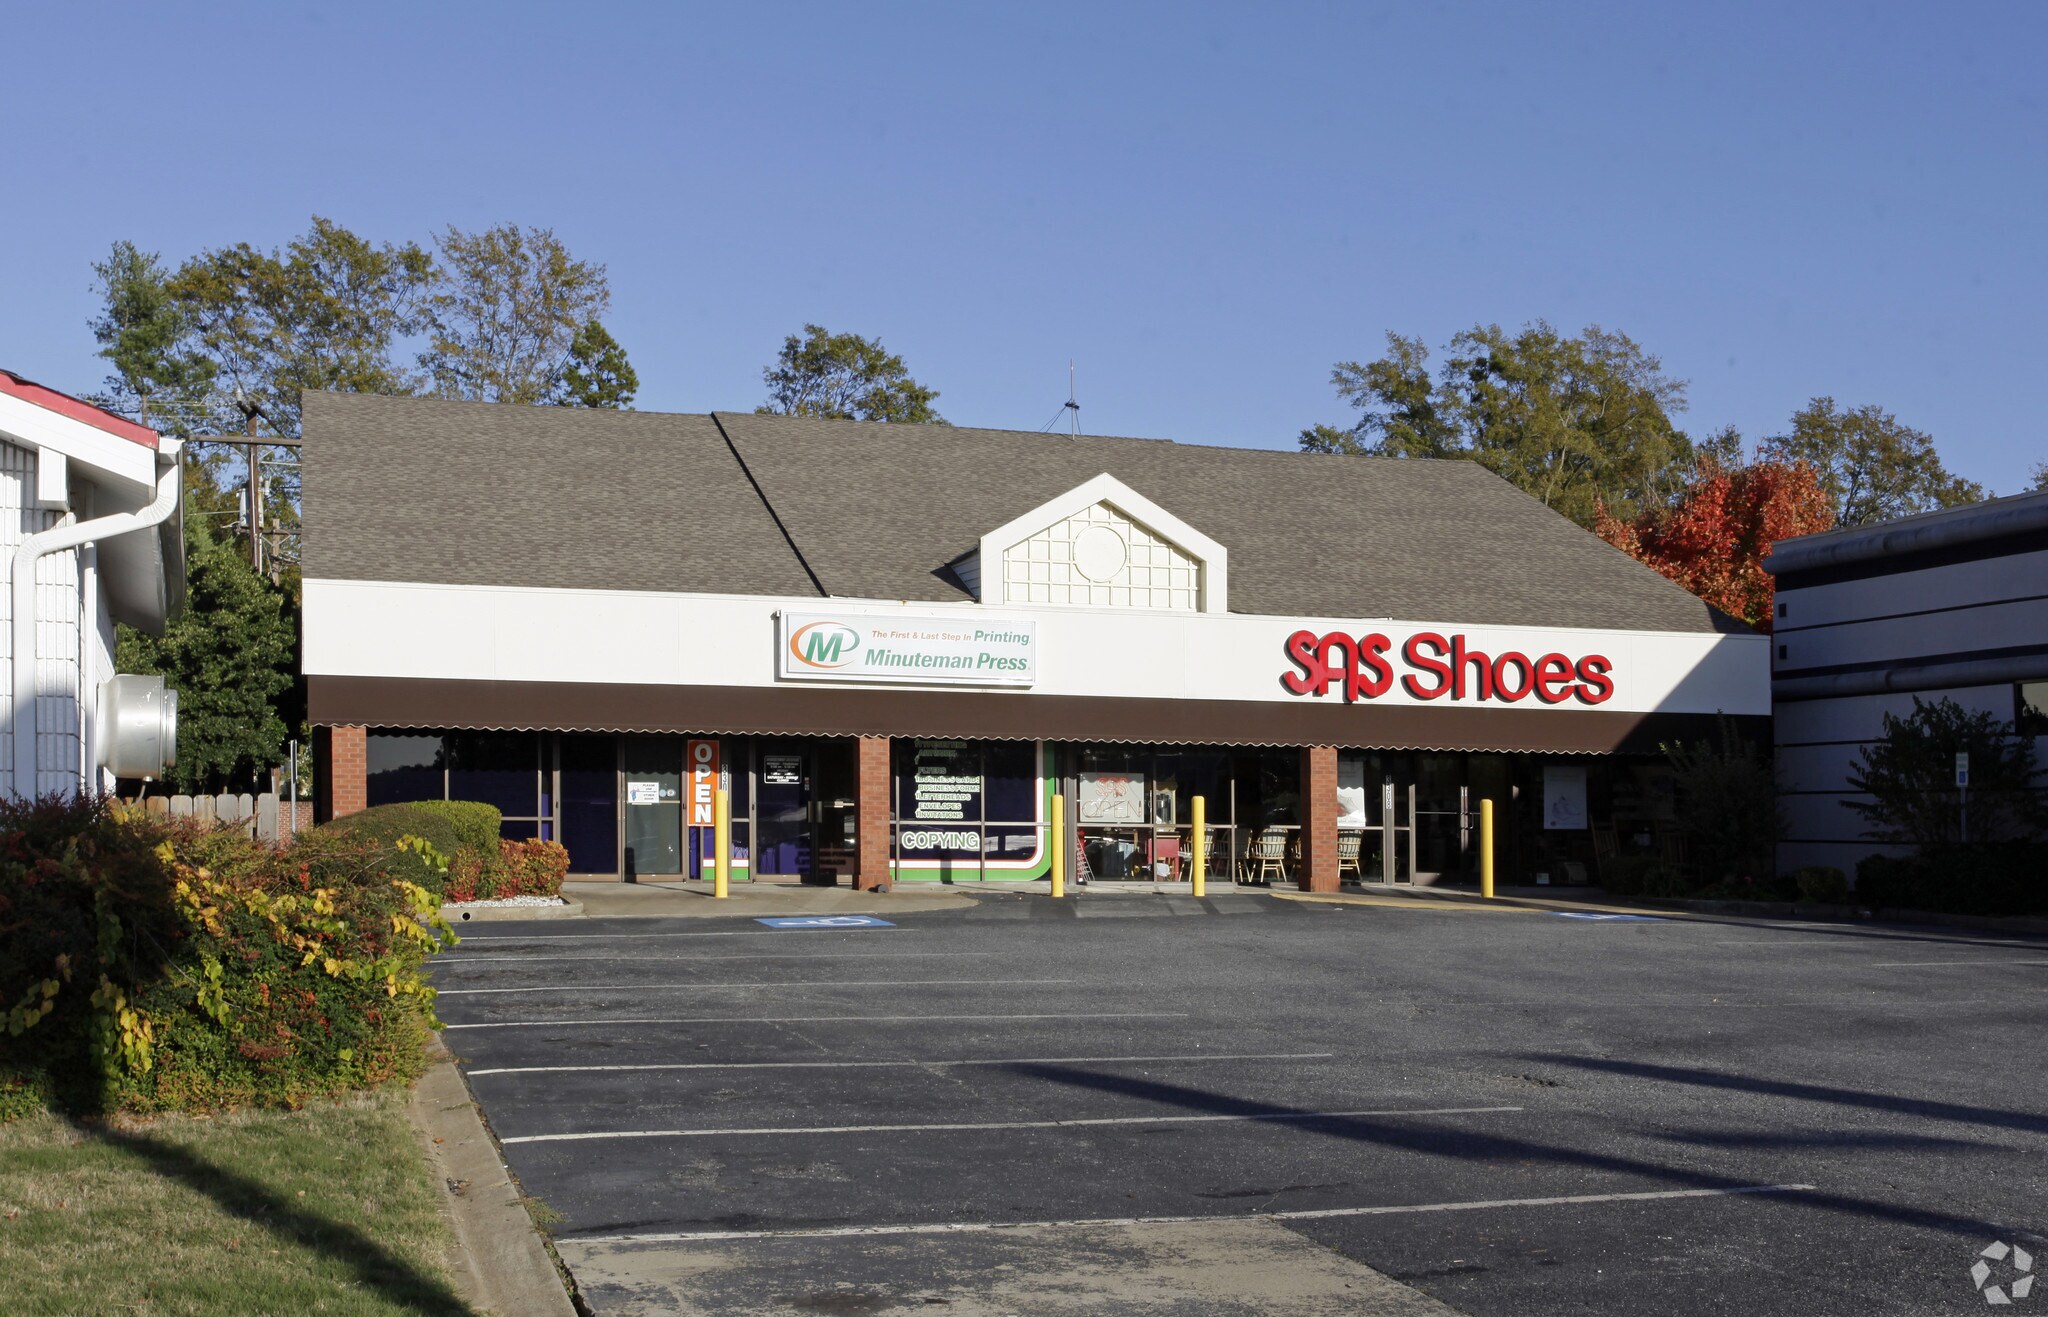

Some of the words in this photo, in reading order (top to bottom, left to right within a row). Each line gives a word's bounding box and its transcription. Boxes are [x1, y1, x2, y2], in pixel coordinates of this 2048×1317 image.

[872, 630, 888, 638] The
[890, 631, 910, 639] First
[920, 632, 939, 640] Last
[941, 633, 961, 642] Step
[974, 630, 1030, 646] Printing
[864, 649, 973, 669] Minuteman
[976, 652, 1028, 671] Press
[1279, 630, 1394, 704] SAS
[1400, 632, 1615, 705] Shoes
[694, 743, 713, 823] OPEN
[918, 784, 955, 792] BUSINESS
[917, 793, 972, 801] LETTERHEADS
[918, 802, 962, 810] ENVELOPES
[1082, 800, 1142, 818] OPEN
[916, 811, 964, 819] INVITATIONS
[902, 831, 980, 850] COPYING
